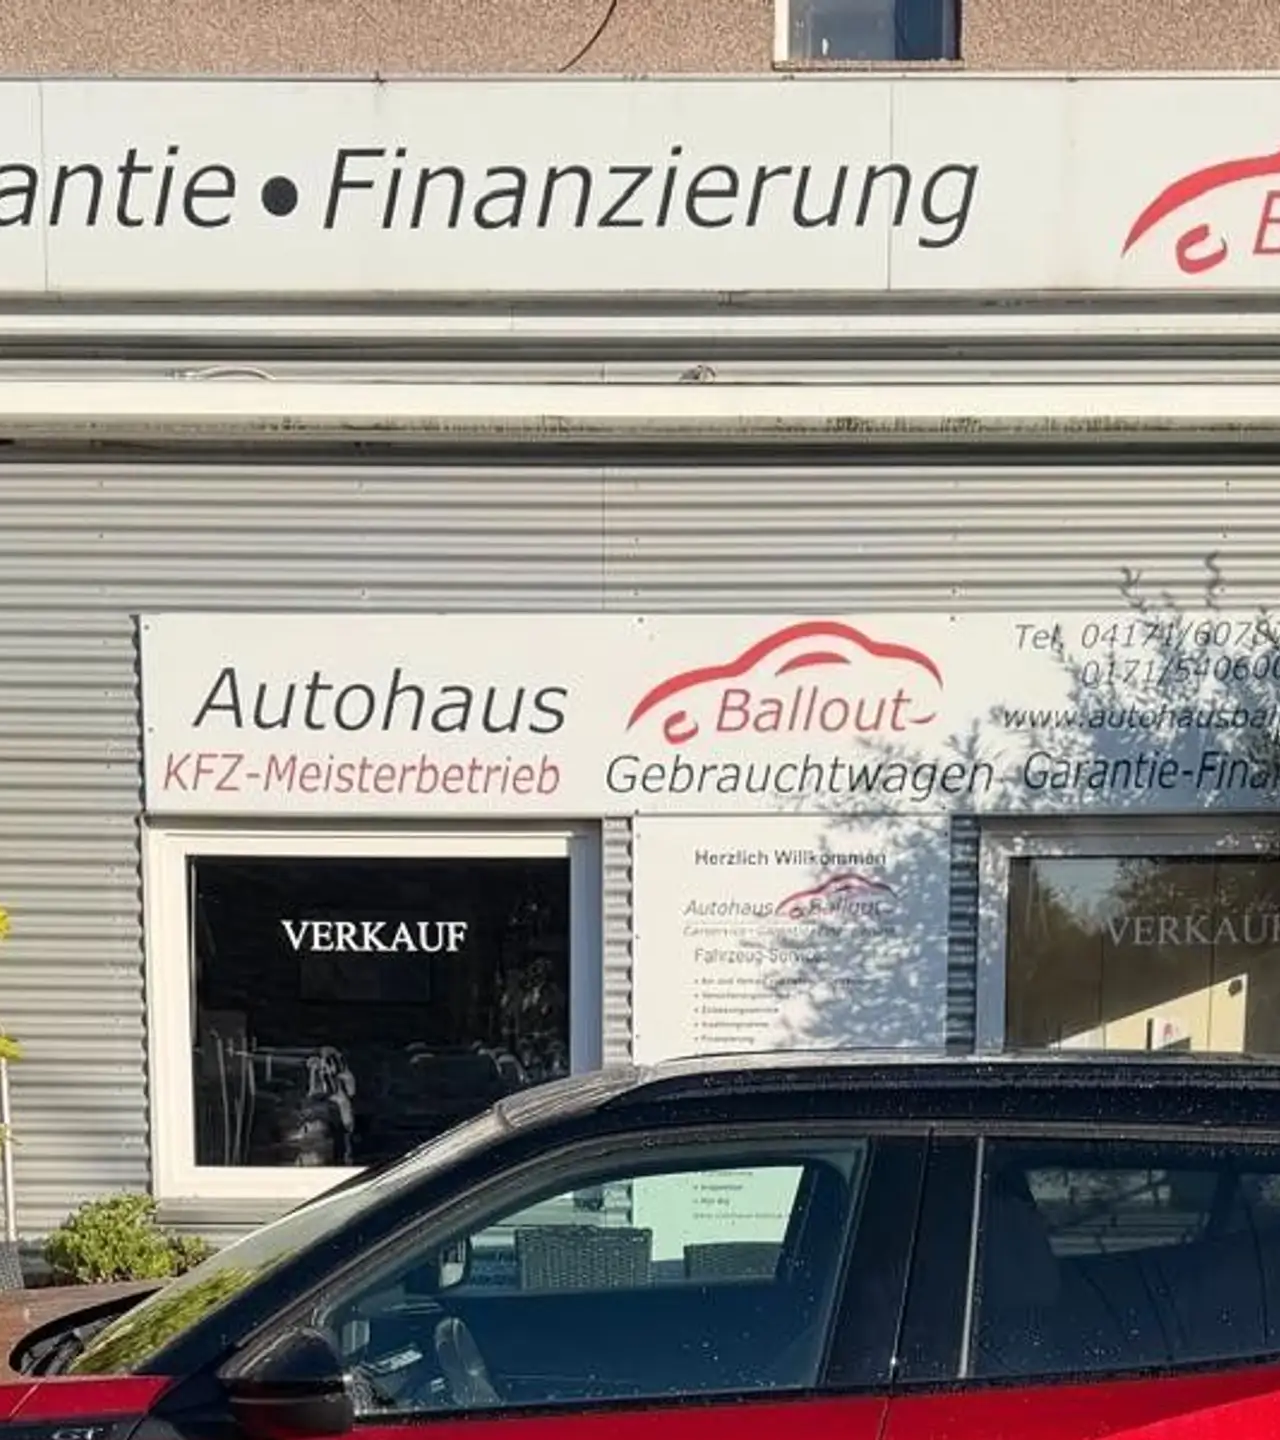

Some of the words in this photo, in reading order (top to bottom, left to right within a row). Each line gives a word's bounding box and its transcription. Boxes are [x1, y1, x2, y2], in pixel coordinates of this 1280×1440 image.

[323, 146, 979, 249] Finanzierung
[192, 667, 569, 734] Autohaus
[715, 686, 913, 733] Ballout
[163, 753, 561, 796] KFZ-Meisterbetrieb
[606, 754, 994, 803] Gebrauchtwagen
[694, 849, 769, 866] Herzlich
[683, 899, 775, 917] Autohaus
[281, 920, 468, 952] VERKAUF
